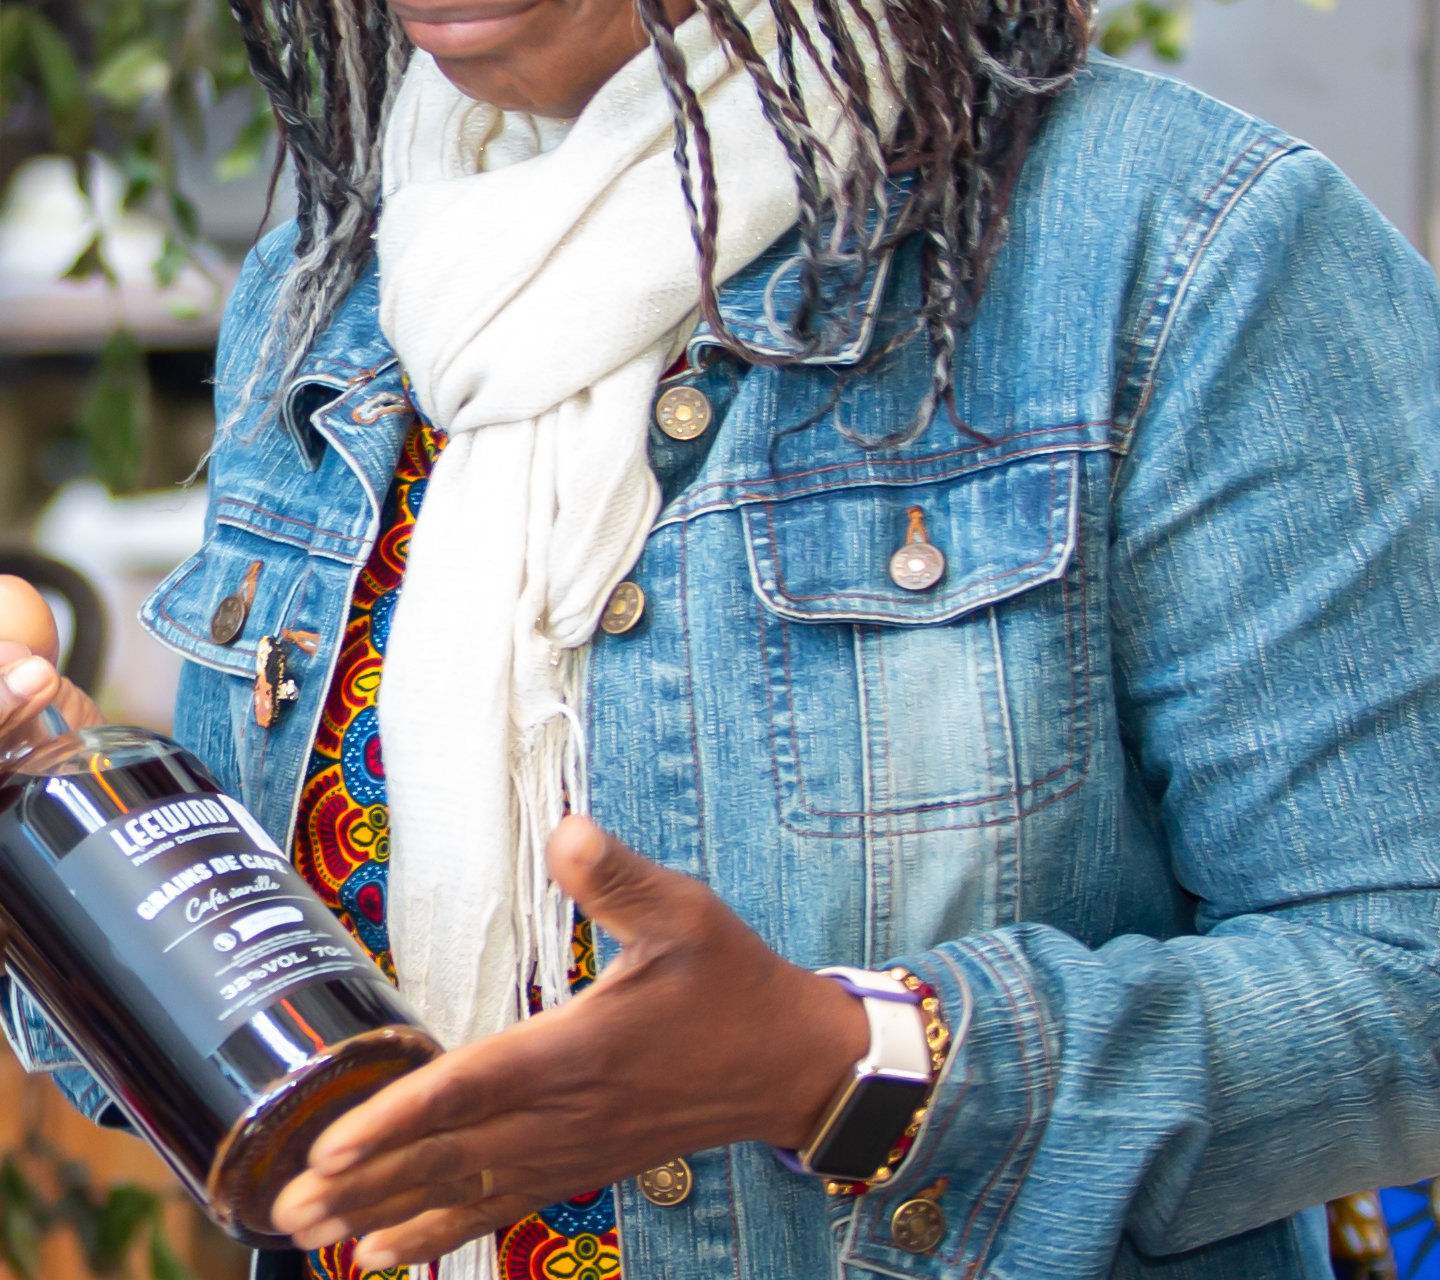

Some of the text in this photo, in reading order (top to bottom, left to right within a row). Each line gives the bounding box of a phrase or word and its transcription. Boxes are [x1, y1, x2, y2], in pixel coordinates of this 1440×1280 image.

[110, 798, 230, 856] LEEWIND
[136, 863, 214, 920] GRAINS
[208, 854, 243, 875] DE
